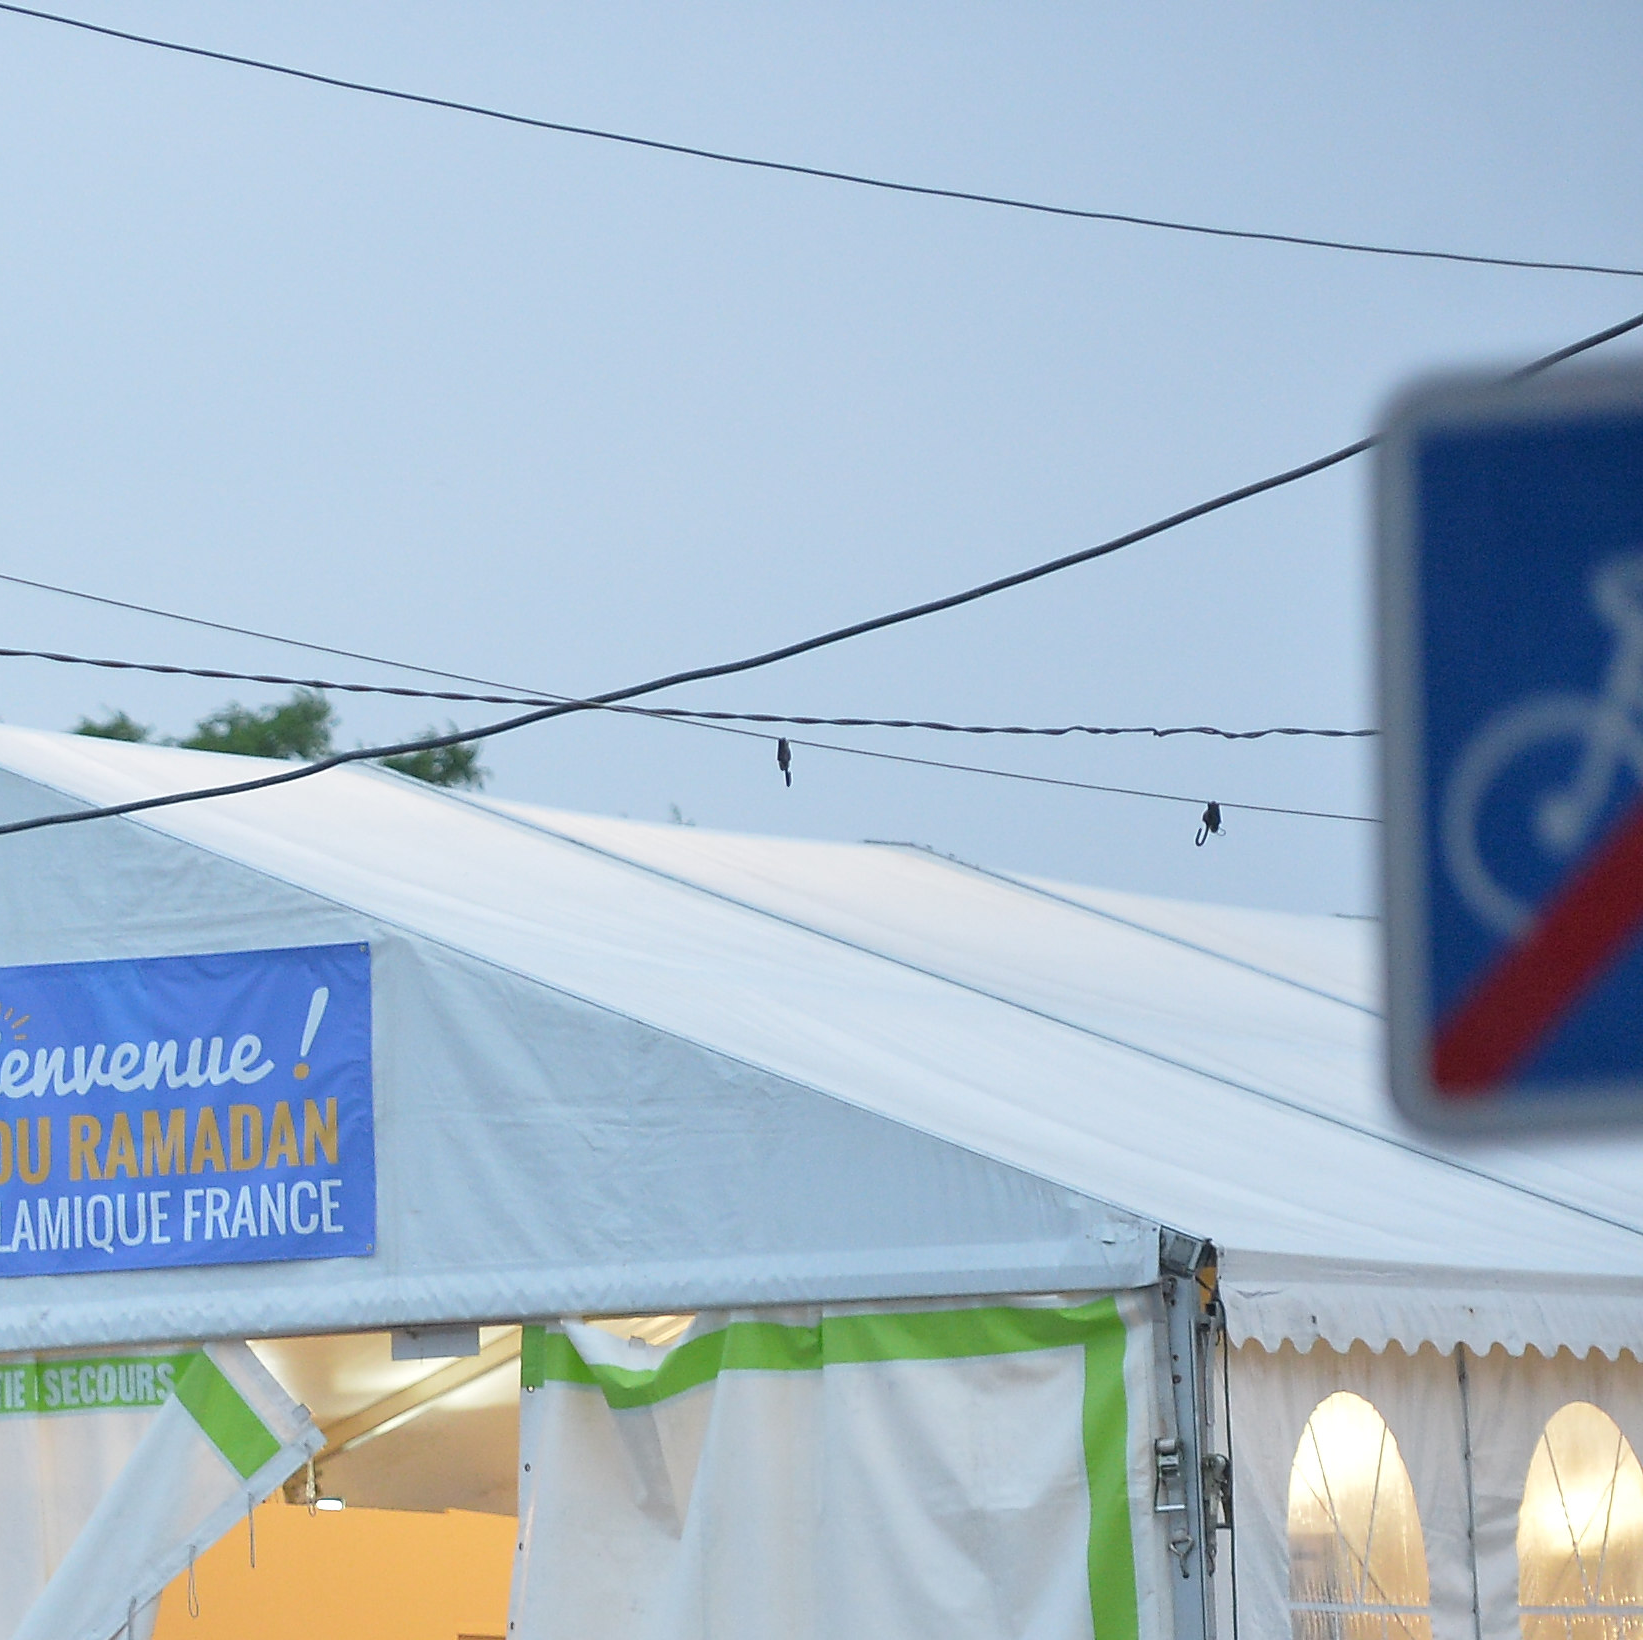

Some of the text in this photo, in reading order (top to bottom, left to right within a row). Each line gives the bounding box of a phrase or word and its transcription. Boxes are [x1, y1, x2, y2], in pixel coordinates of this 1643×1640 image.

[292, 986, 330, 1081] !
[68, 1096, 339, 1182] RAMADAN
[183, 1177, 345, 1242] FRANCE
[43, 1362, 176, 1407] SECOURS
